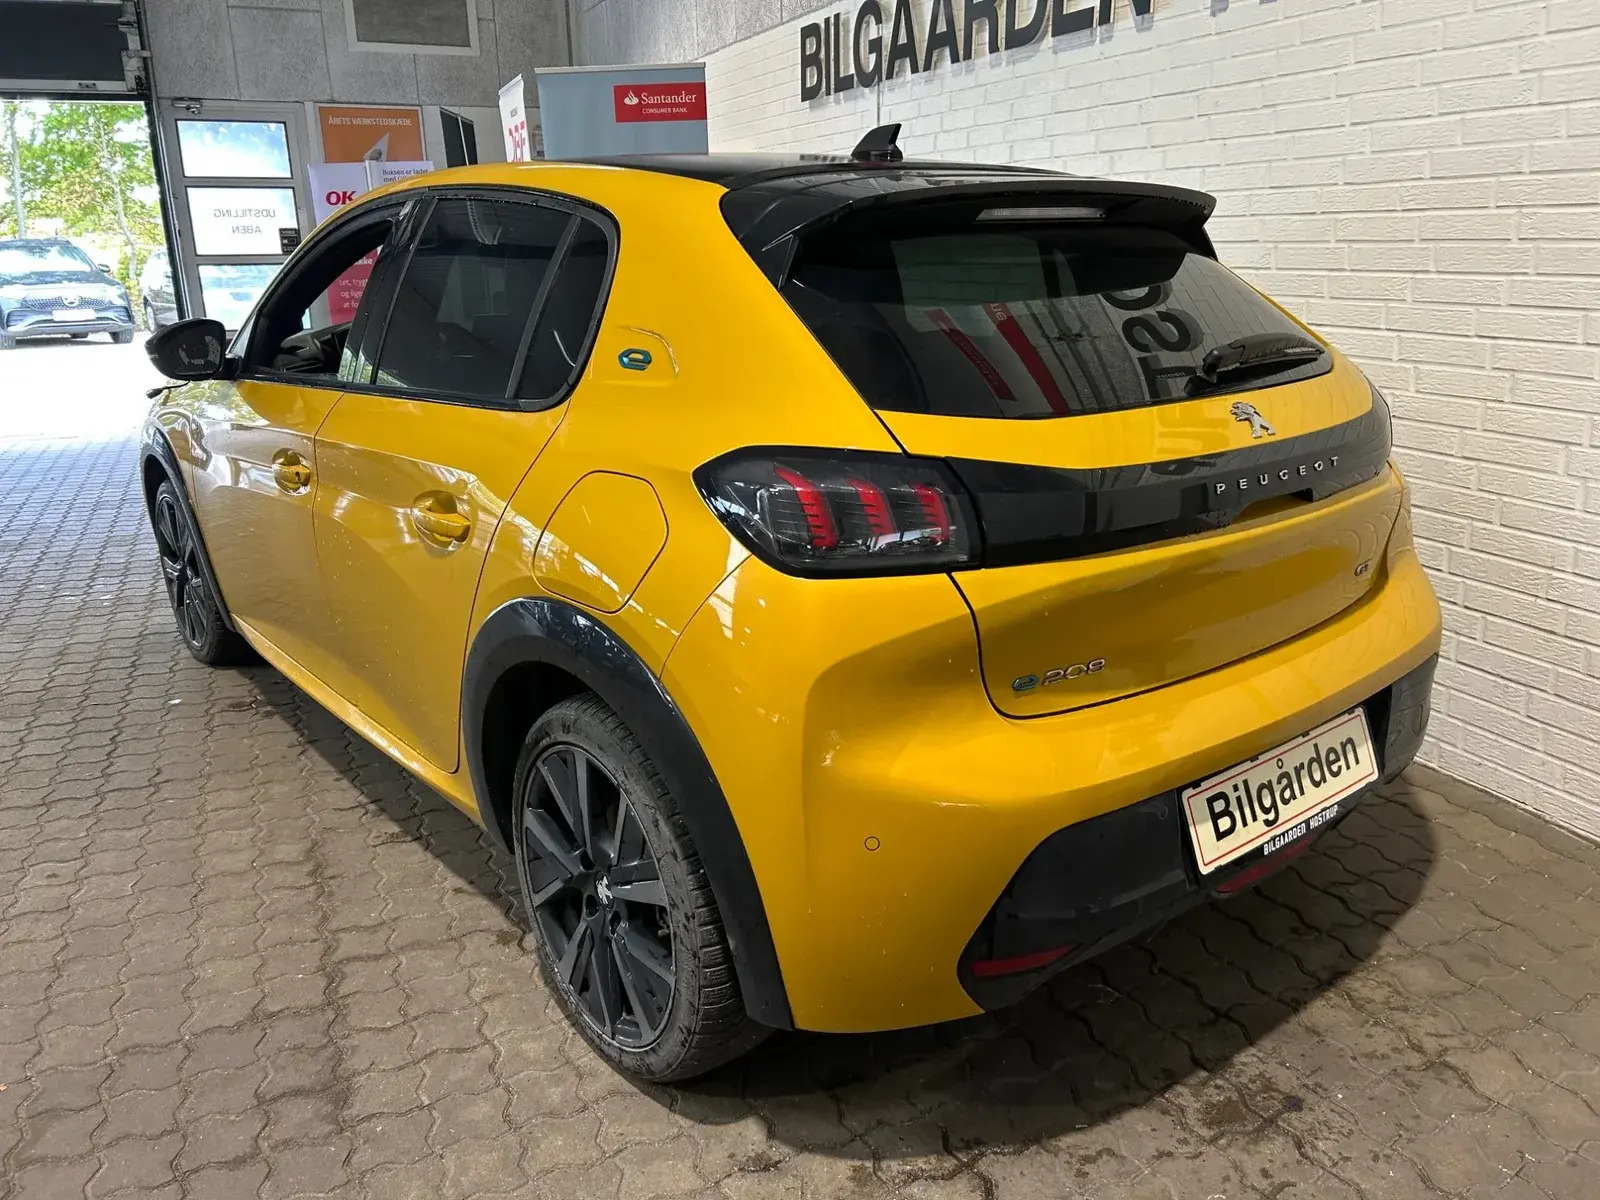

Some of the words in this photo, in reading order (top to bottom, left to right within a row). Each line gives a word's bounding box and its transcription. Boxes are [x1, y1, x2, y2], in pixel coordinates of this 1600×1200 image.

[801, 0, 1152, 102] BILGAARD
[641, 91, 697, 104] Santander
[328, 115, 351, 125] ÅRETS
[325, 190, 356, 206] OK
[351, 300, 359, 308] fo
[1215, 456, 1339, 494] PEUGEOT
[1205, 736, 1360, 842] Bilgården
[1263, 822, 1306, 855] BILGAARDEN
